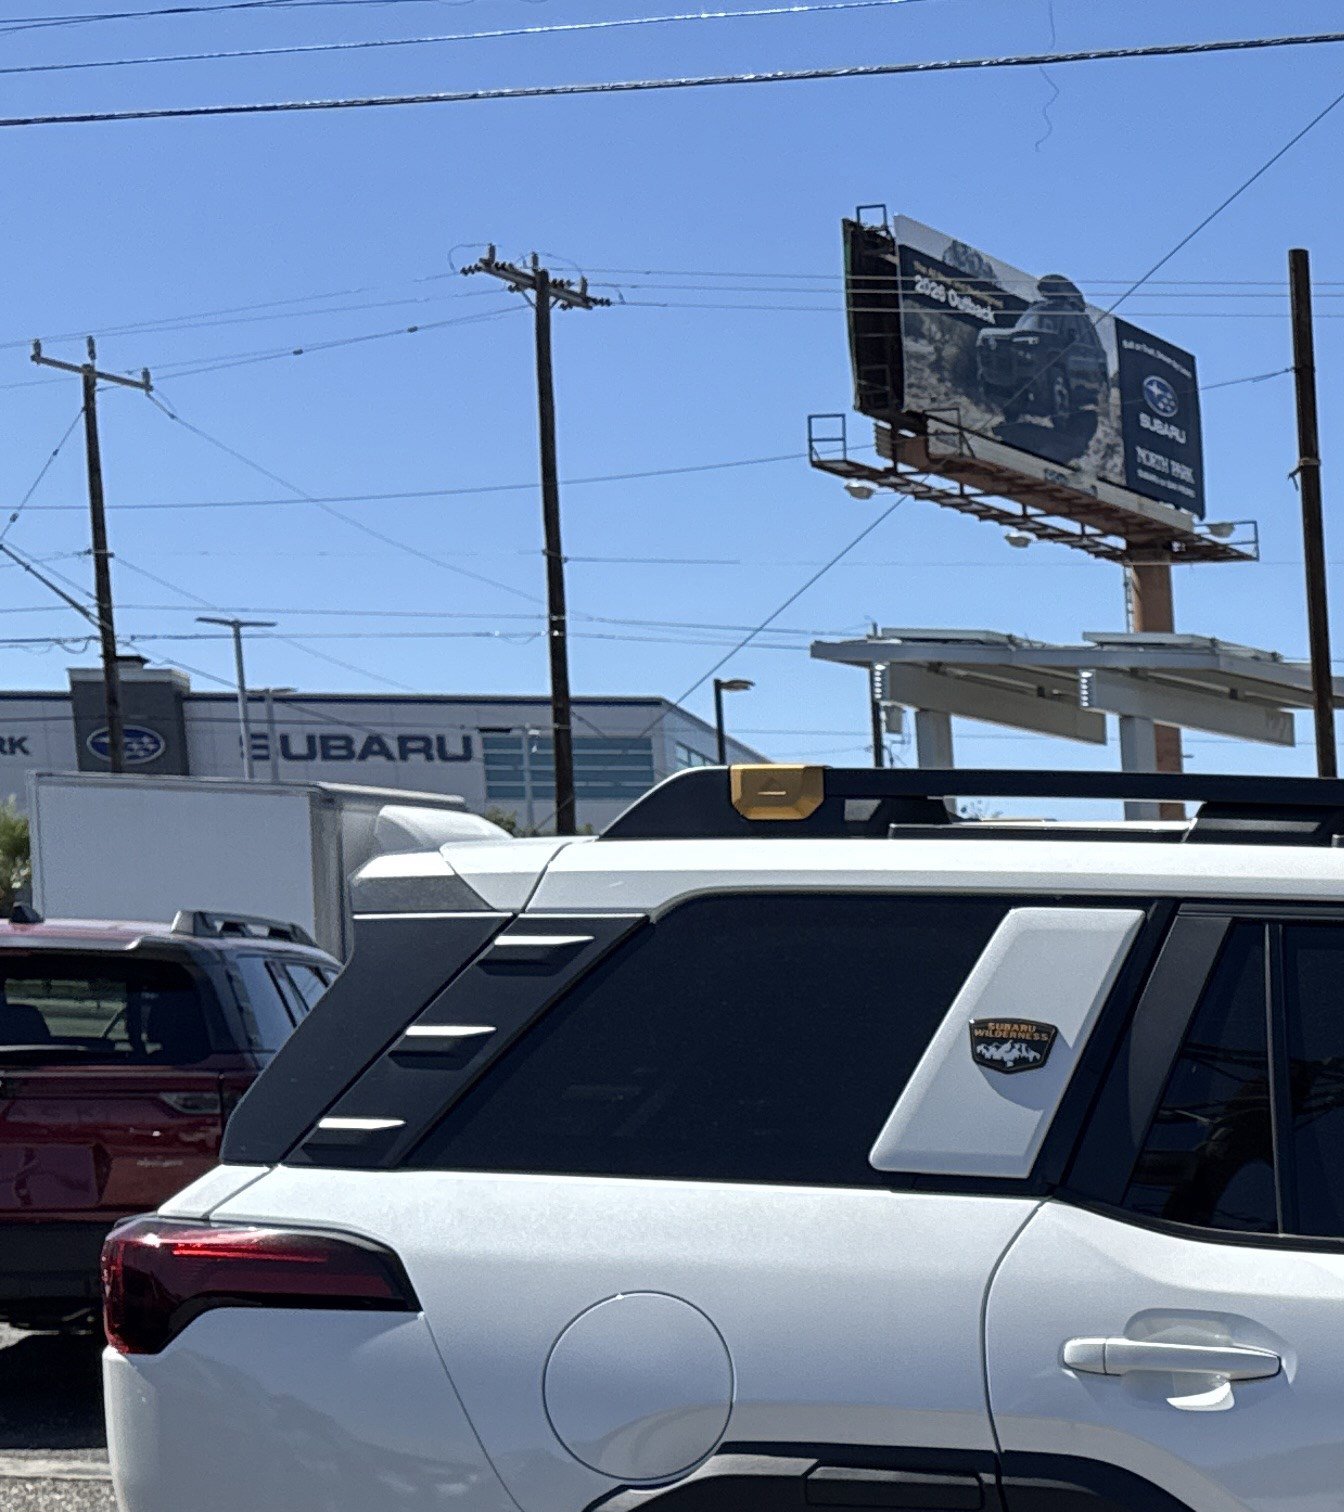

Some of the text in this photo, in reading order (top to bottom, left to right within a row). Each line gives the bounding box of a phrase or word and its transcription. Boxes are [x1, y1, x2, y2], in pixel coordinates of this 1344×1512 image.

[240, 733, 473, 763] SUBARU
[988, 1022, 1037, 1033] SUBARU
[974, 1029, 1049, 1041] WILDERNESS
